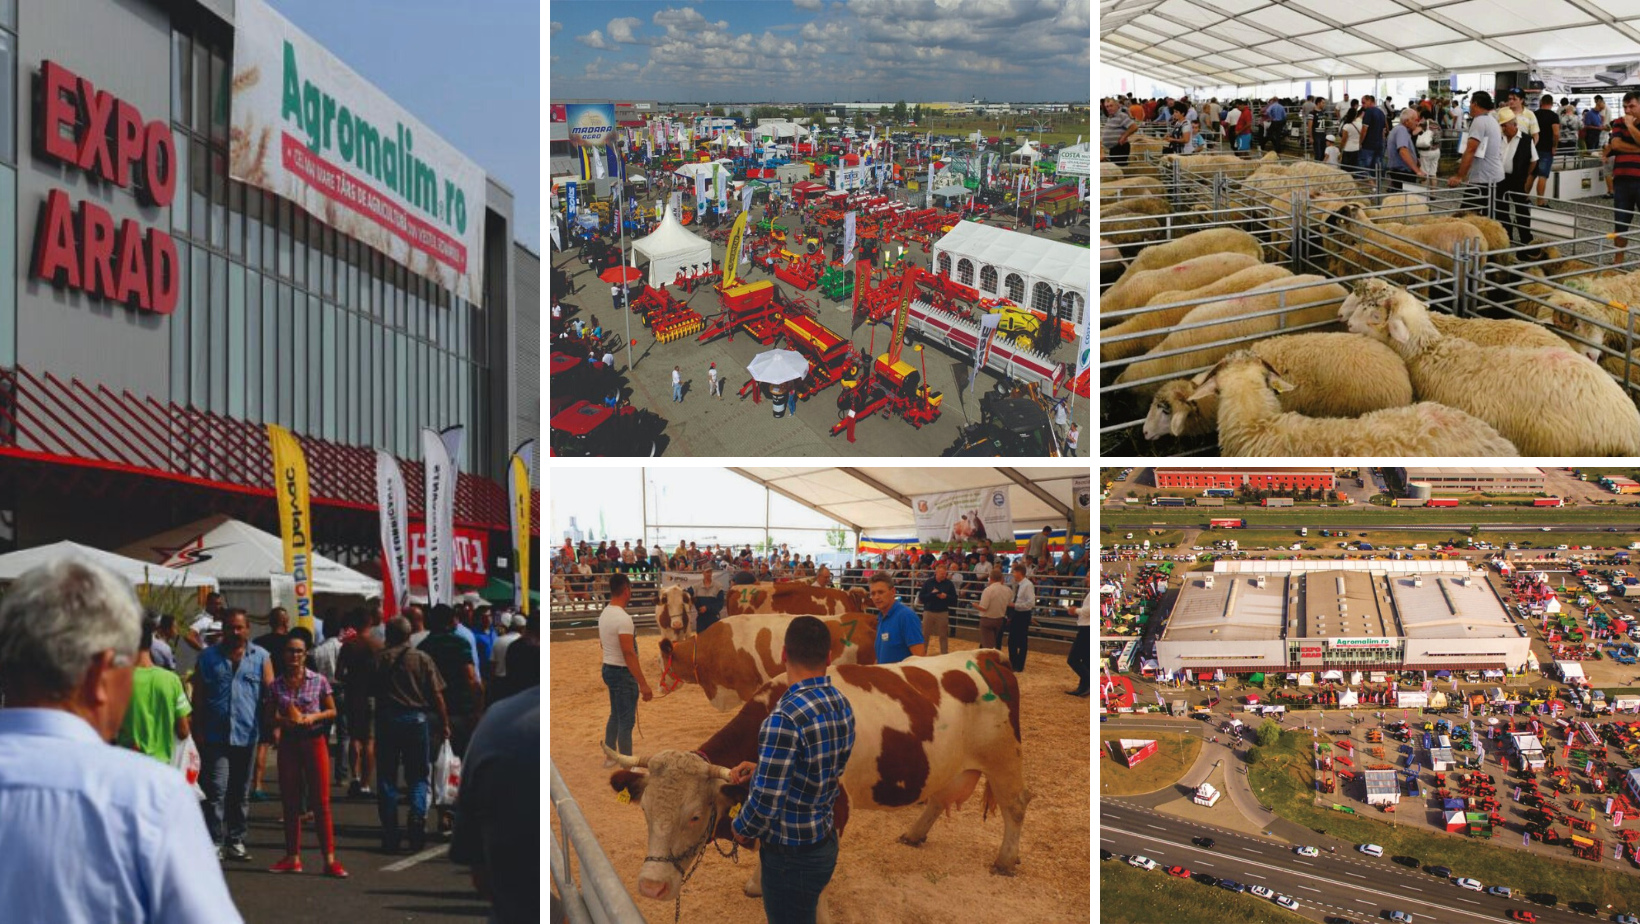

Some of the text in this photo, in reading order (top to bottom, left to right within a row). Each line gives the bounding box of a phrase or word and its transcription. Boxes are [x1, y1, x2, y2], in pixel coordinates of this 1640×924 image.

[41, 59, 177, 207] EXPO
[571, 126, 613, 134] MADARA
[568, 186, 576, 214] SOLIS
[39, 188, 180, 316] ARAD
